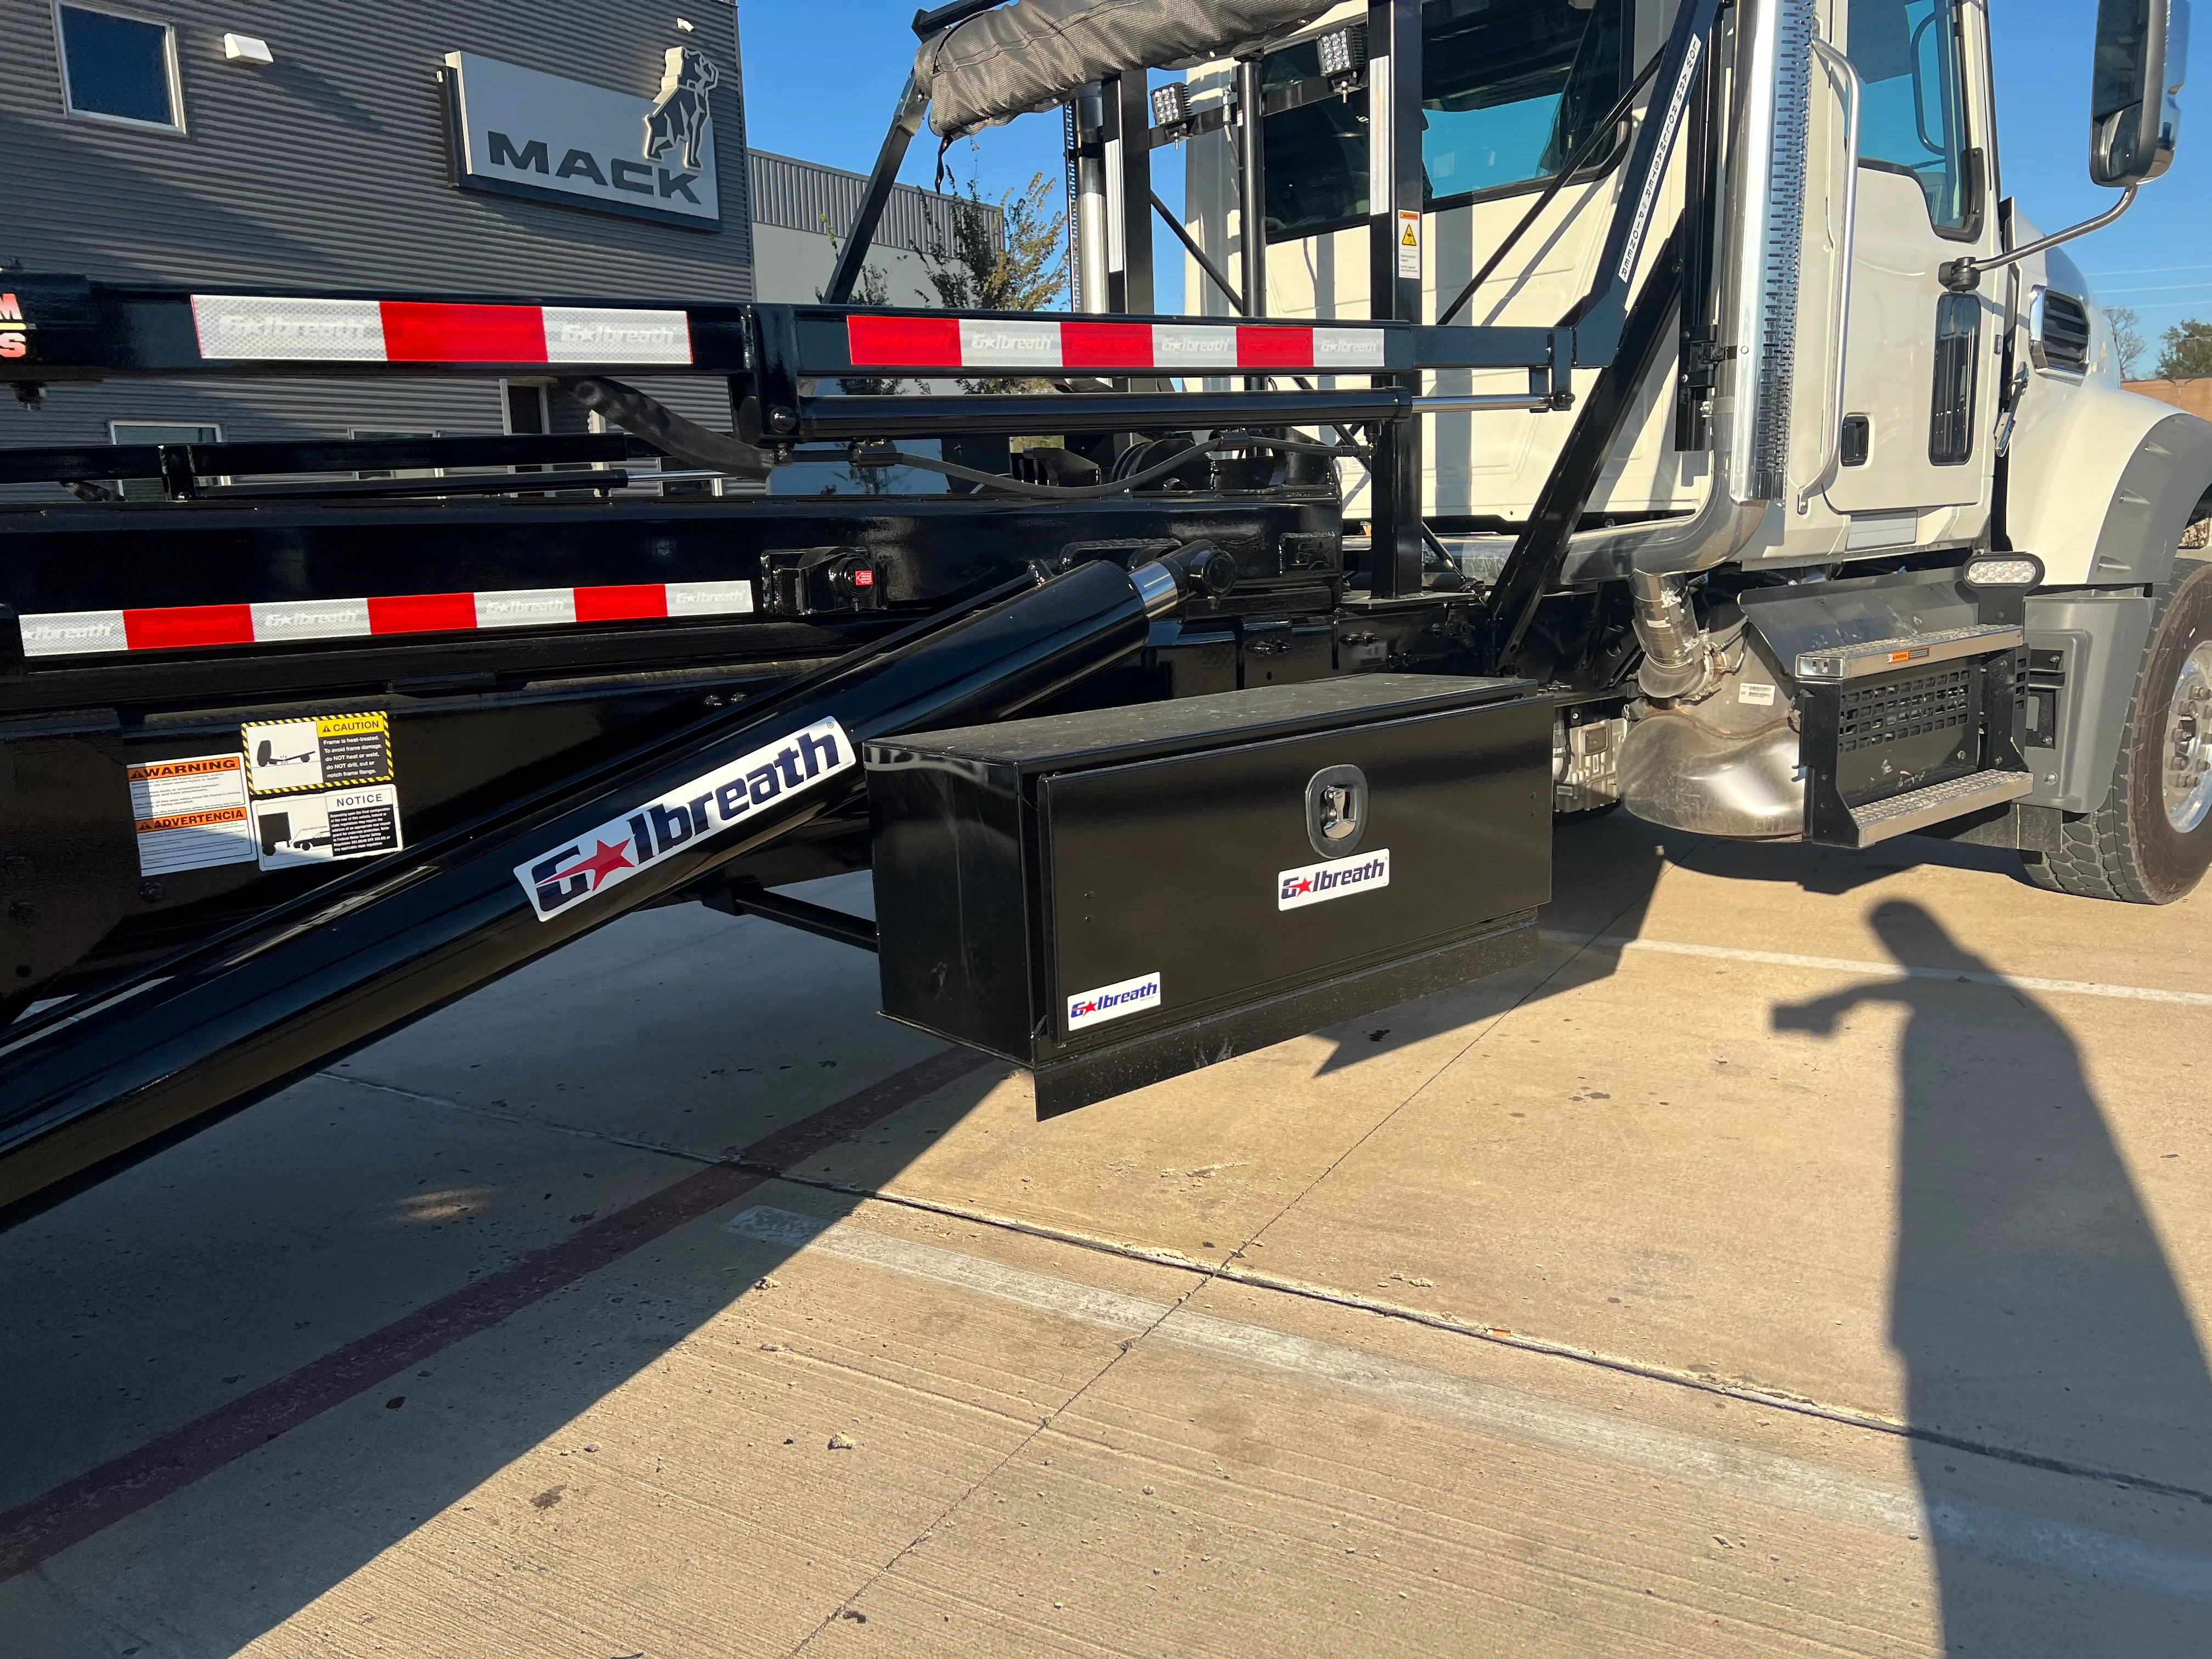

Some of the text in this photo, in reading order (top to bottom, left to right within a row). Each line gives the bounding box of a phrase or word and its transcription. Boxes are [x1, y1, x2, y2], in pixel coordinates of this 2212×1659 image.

[1686, 41, 1696, 69] LOW
[1676, 74, 1686, 101] ARM
[1645, 105, 1677, 199] ROLLMASTER
[488, 131, 701, 204] MACK
[1621, 211, 1644, 278] PIONEER
[333, 720, 380, 732] CAUTION
[143, 760, 236, 777] WARNING
[336, 793, 383, 807] NOTICE
[154, 810, 244, 828] ADVERTENCIA
